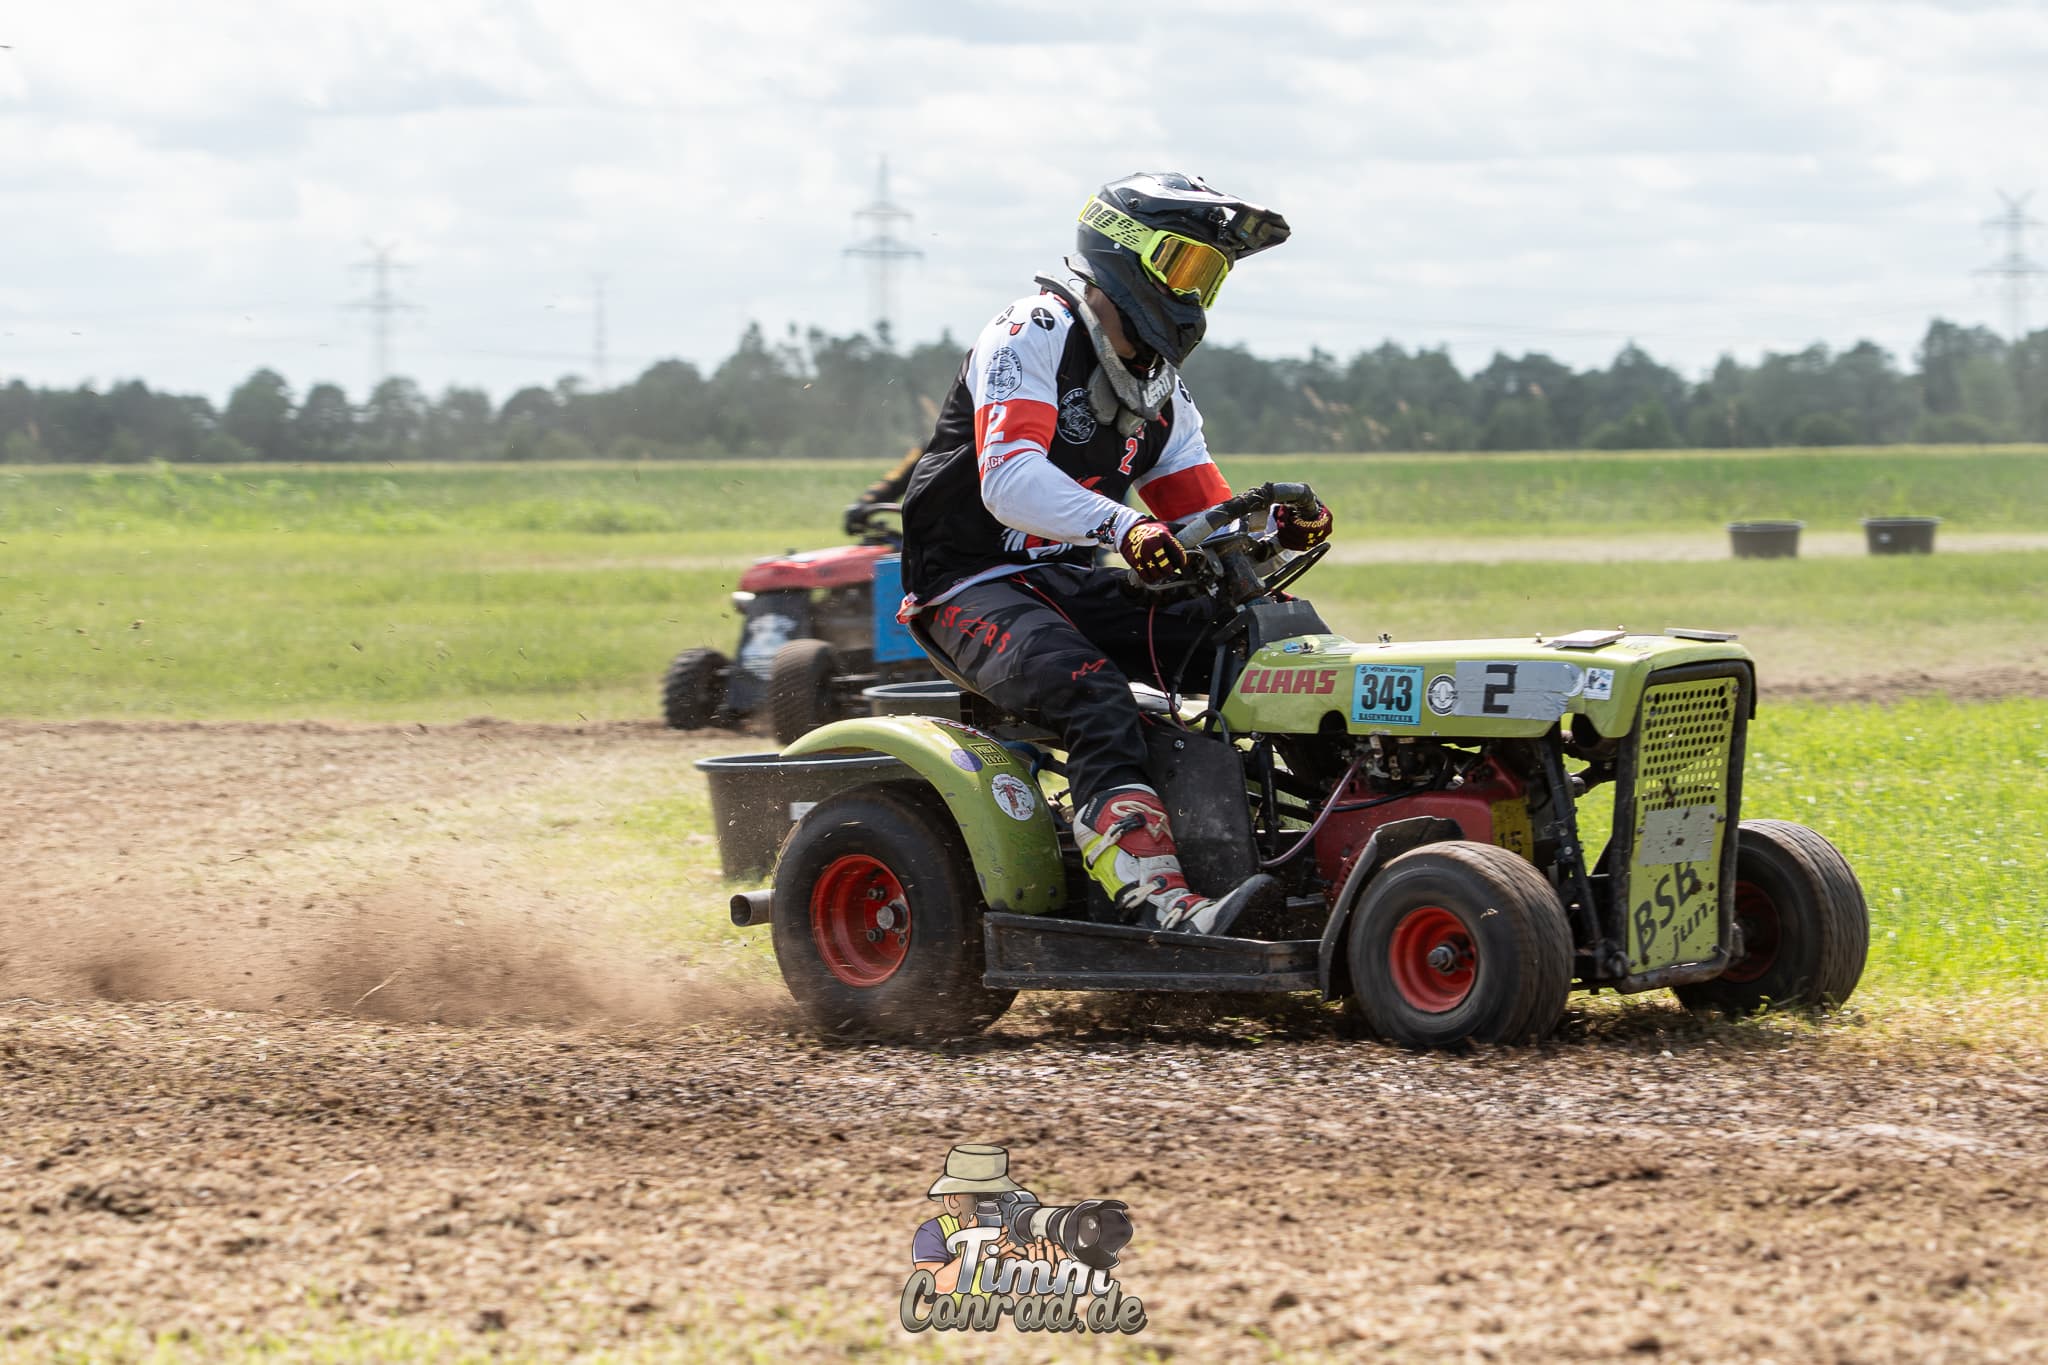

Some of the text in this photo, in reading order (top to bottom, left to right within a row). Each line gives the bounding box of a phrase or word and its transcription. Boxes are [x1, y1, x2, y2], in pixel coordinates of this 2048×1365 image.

[985, 404, 1007, 446] 2
[1118, 437, 1138, 475] 2
[1240, 669, 1338, 694] CLAAS
[1361, 674, 1413, 712] 343
[1482, 664, 1518, 714] 2
